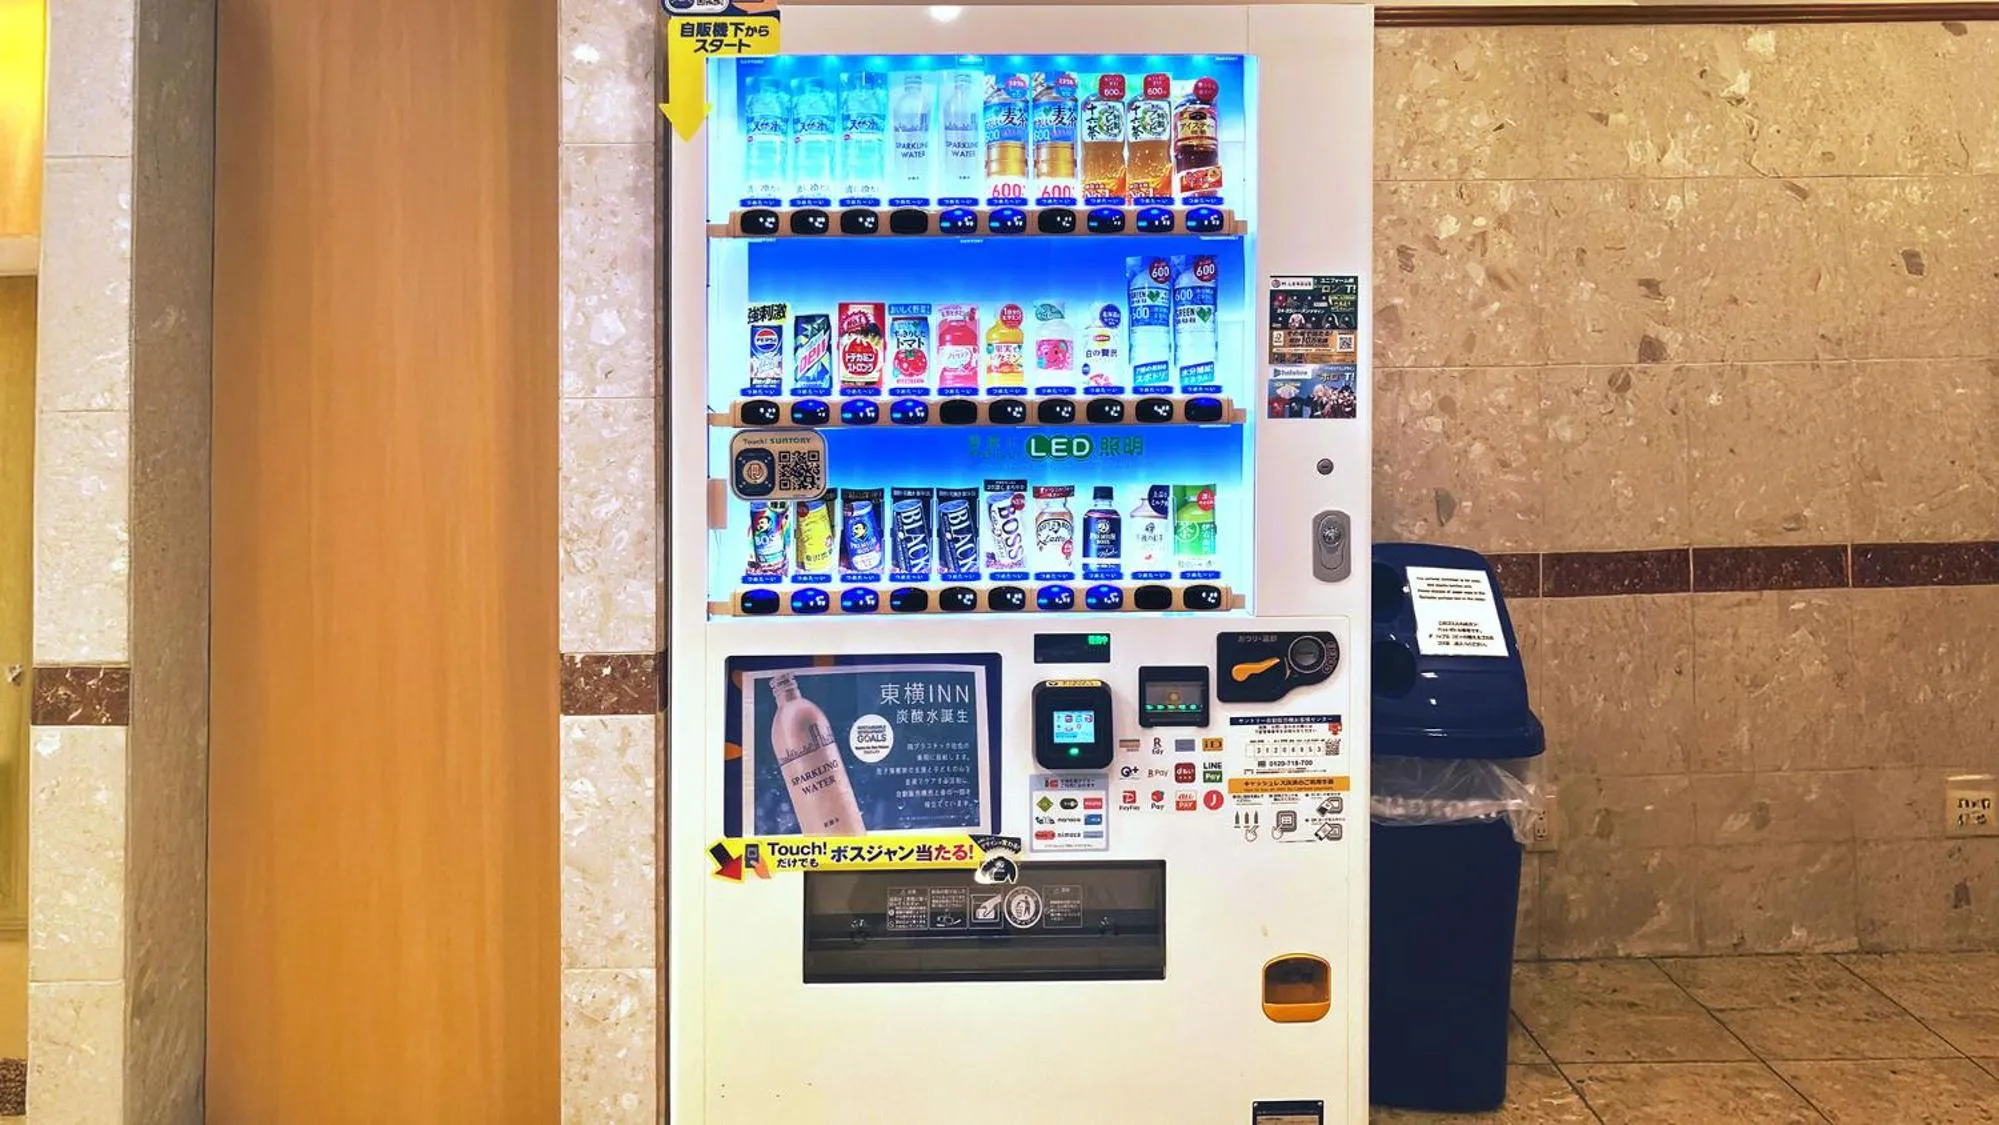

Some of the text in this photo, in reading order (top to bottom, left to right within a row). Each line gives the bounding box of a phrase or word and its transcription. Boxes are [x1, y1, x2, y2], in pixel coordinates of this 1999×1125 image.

[680, 22, 770, 38] 自販機下から
[693, 39, 751, 53] スタート
[1086, 103, 1100, 140] 十六茶
[1130, 103, 1144, 140] 十六茶
[1151, 266, 1170, 278] 600
[1196, 264, 1215, 277] 600
[748, 303, 787, 324] 強刺激
[896, 338, 925, 349] トマト
[770, 437, 811, 445] SUNTORY
[1030, 438, 1091, 457] LED
[901, 506, 930, 573] BLACK
[948, 507, 977, 573] BLACK
[997, 506, 1025, 560] BOSS
[880, 682, 970, 706] 東横INN
[896, 708, 969, 725] 炭酸水誕生
[857, 733, 887, 743] GOALS
[791, 759, 839, 785] SPARKLING
[801, 775, 836, 796] WATER
[767, 842, 827, 856] Touch!
[830, 843, 974, 863] ボスジャン当たる!
[776, 857, 819, 869] だけでも
